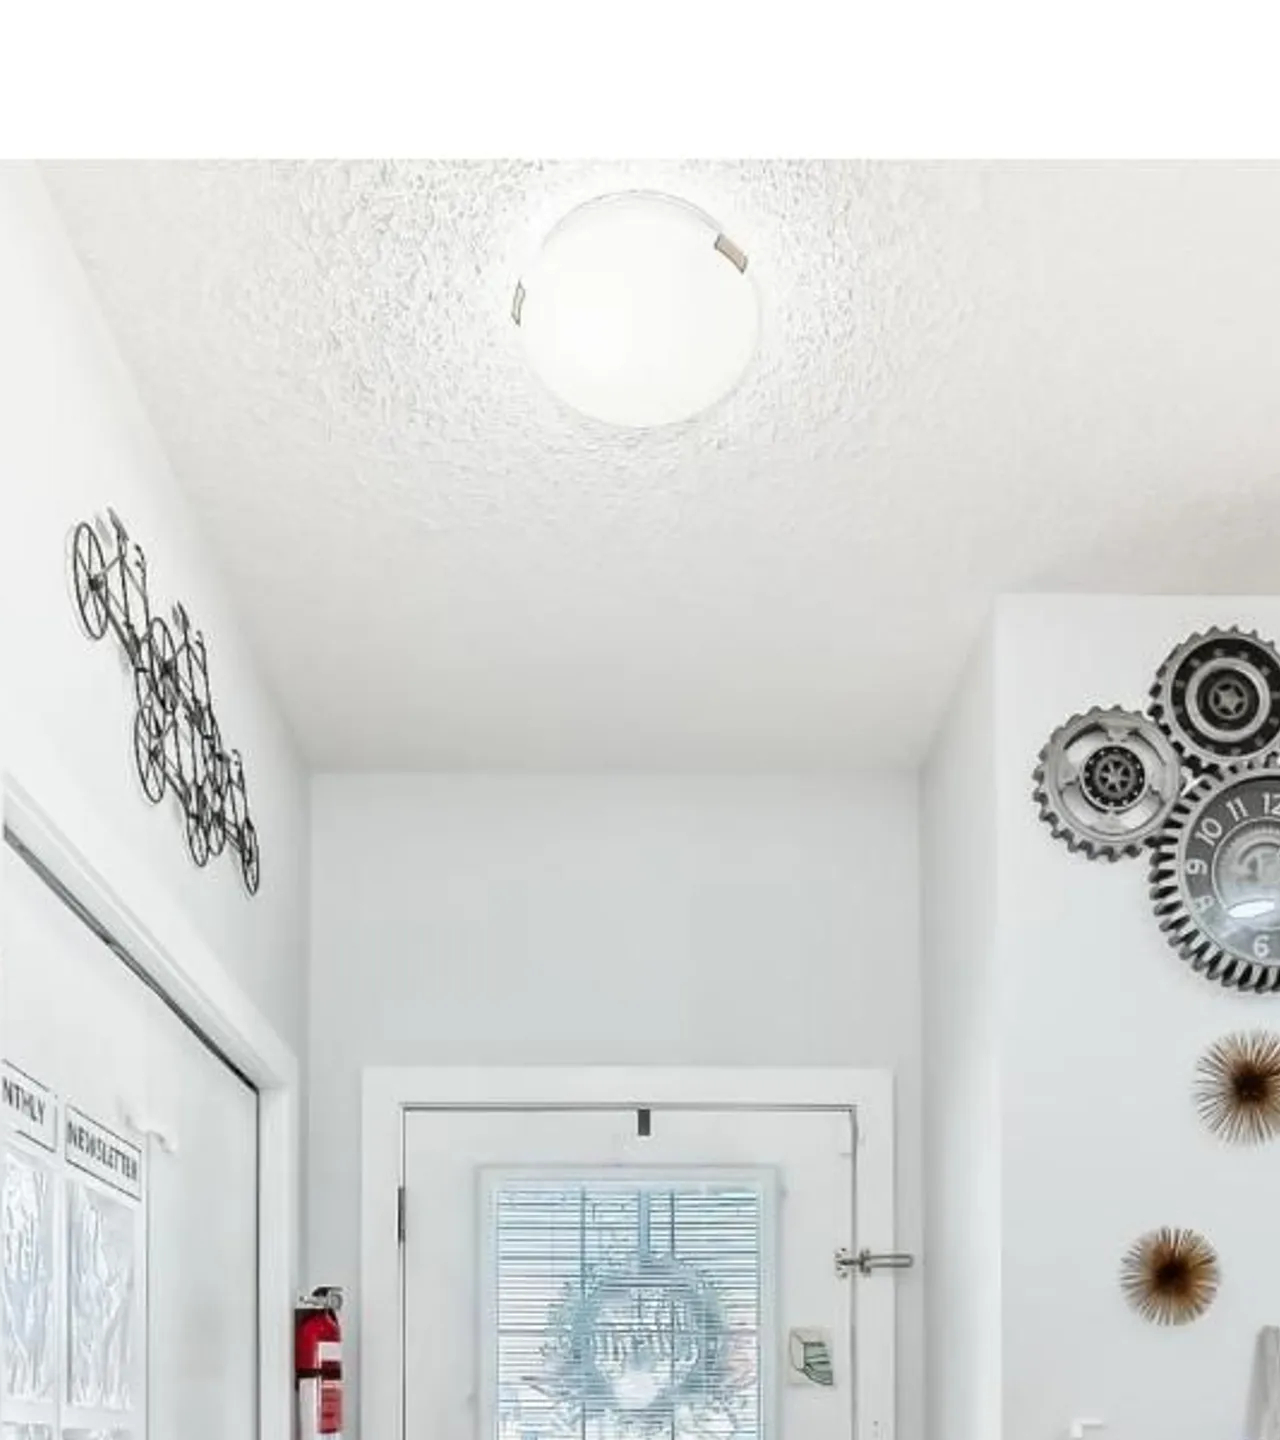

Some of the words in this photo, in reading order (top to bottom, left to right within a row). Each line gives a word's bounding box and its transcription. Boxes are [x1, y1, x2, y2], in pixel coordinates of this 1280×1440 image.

[1226, 797, 1249, 821] 11
[1195, 817, 1222, 846] 10
[1187, 859, 1208, 875] 9
[1253, 934, 1269, 957] 6
[66, 1120, 138, 1182] NEWSLETTER
